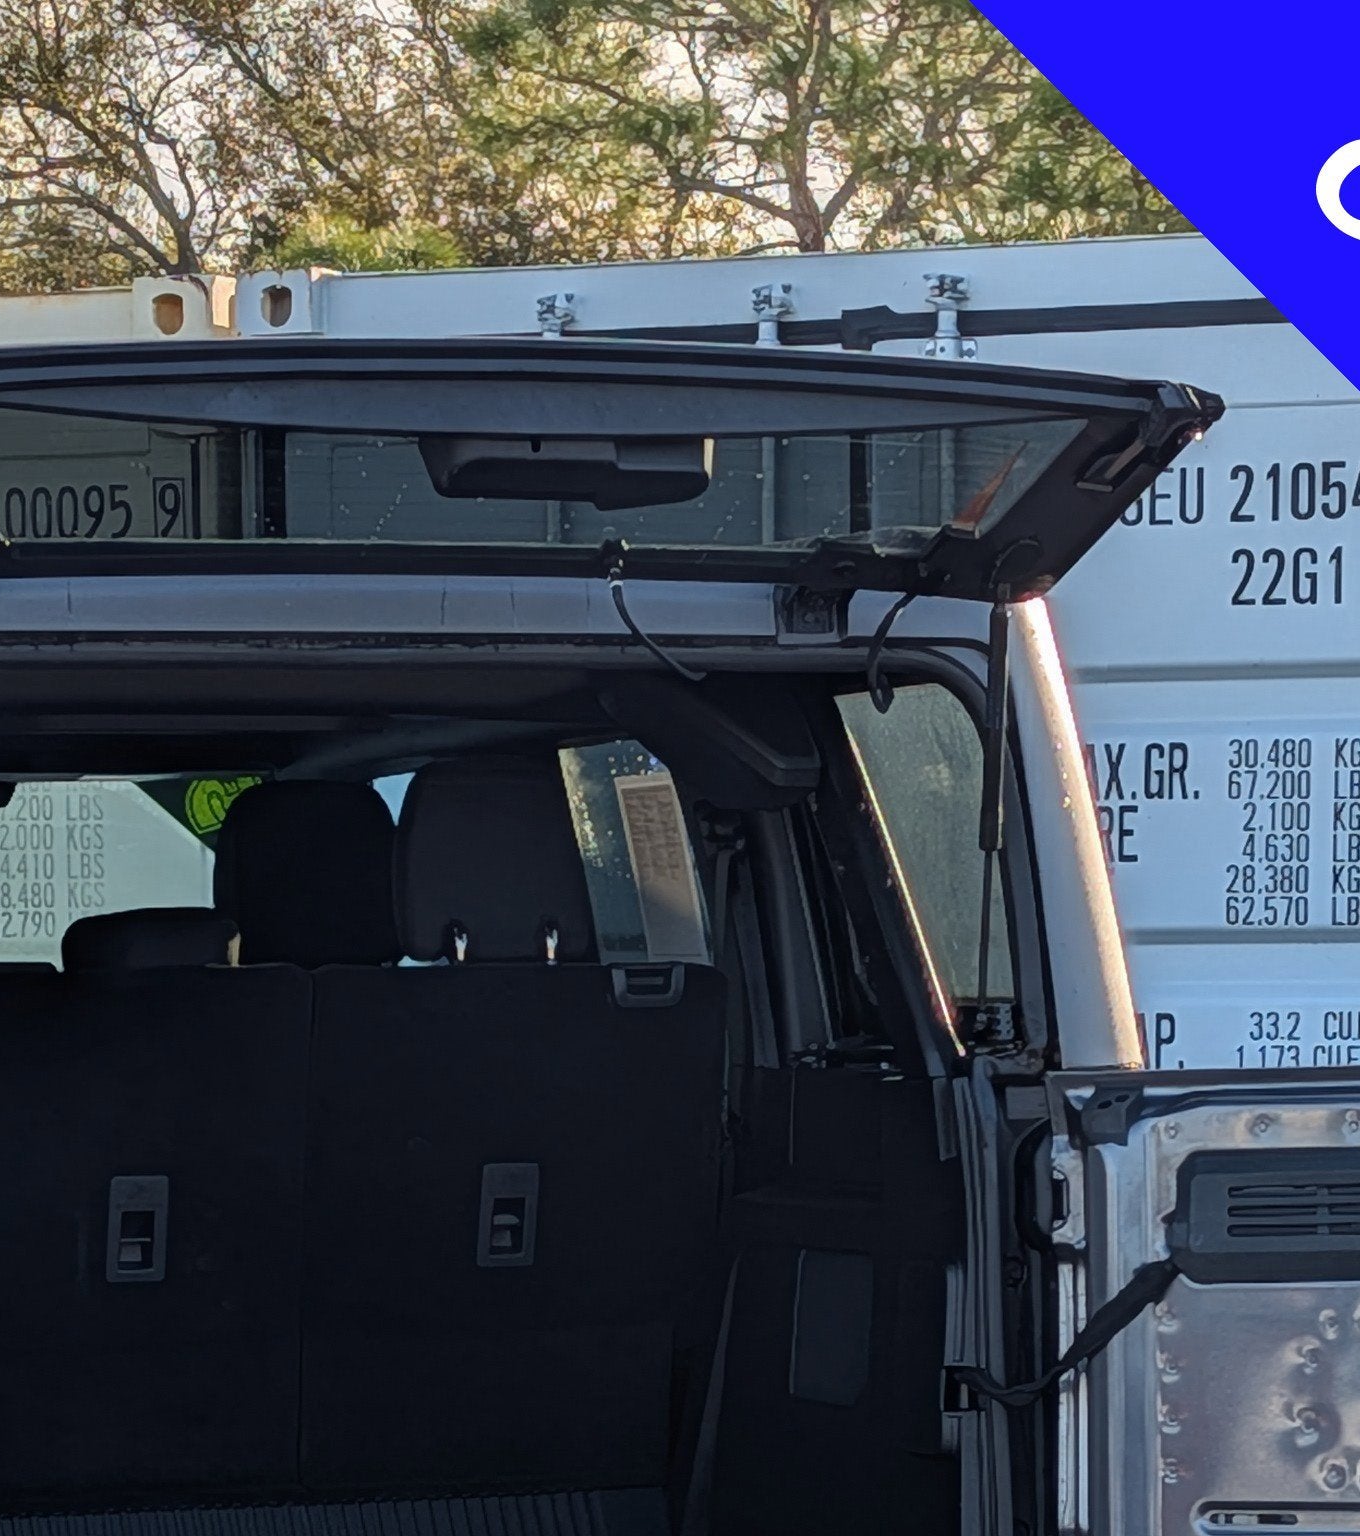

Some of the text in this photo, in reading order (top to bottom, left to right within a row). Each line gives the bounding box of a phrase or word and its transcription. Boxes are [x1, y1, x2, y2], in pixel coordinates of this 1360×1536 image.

[158, 482, 182, 538] 9
[1231, 546, 1344, 606] 22G1
[66, 795, 104, 821] LBS
[66, 824, 105, 851] KGS
[67, 853, 106, 880] LBS
[67, 882, 106, 909] KGS
[1249, 1011, 1301, 1041] 33.2
